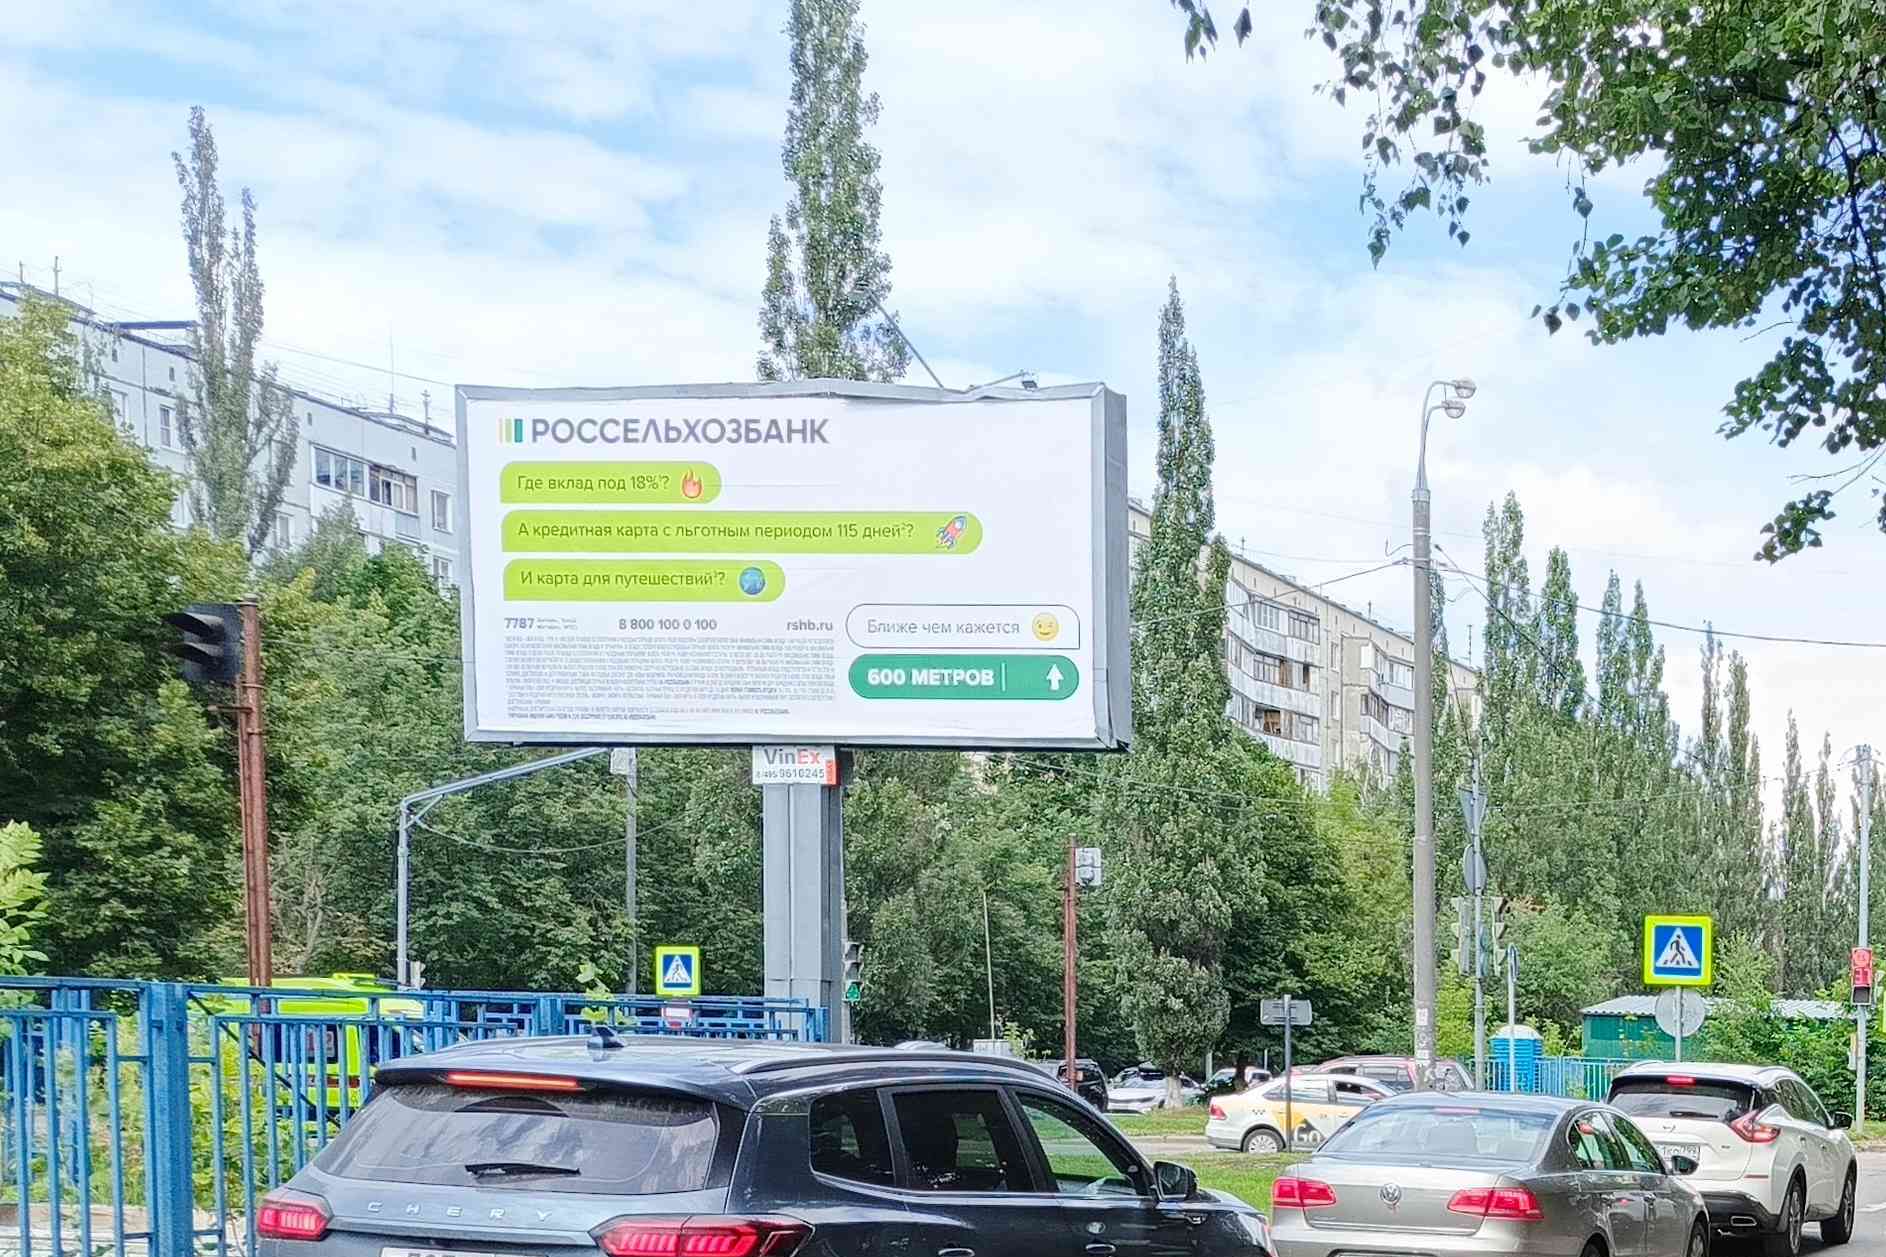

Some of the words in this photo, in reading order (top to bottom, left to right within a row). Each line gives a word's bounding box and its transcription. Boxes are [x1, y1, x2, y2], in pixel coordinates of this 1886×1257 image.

[531, 418, 830, 444] РОССЕЛЬХОЗБАНК
[517, 475, 543, 491] Где
[548, 477, 594, 491] вклад
[598, 477, 626, 491] под
[518, 523, 529, 536] А
[533, 525, 612, 539] кредитная
[616, 525, 658, 539] карта
[663, 526, 672, 536] с
[675, 526, 750, 537] льготным
[755, 525, 832, 539] периодом
[837, 524, 858, 536] 115
[520, 571, 533, 584] И
[537, 574, 578, 586] карта
[583, 574, 610, 586] для
[504, 618, 535, 629] 7787
[618, 618, 627, 630] 8
[630, 618, 654, 630] 800
[659, 619, 680, 630] 100
[683, 619, 691, 630] 0
[695, 619, 717, 630] 100
[787, 619, 833, 631] rshb.ru
[867, 619, 918, 634] Ближе
[922, 621, 952, 633] чем
[956, 621, 1020, 633] кажется
[867, 668, 906, 685] 600
[911, 669, 995, 686] МЕТРОВ
[763, 748, 820, 765] VinEx
[367, 1201, 552, 1221] CHERY
